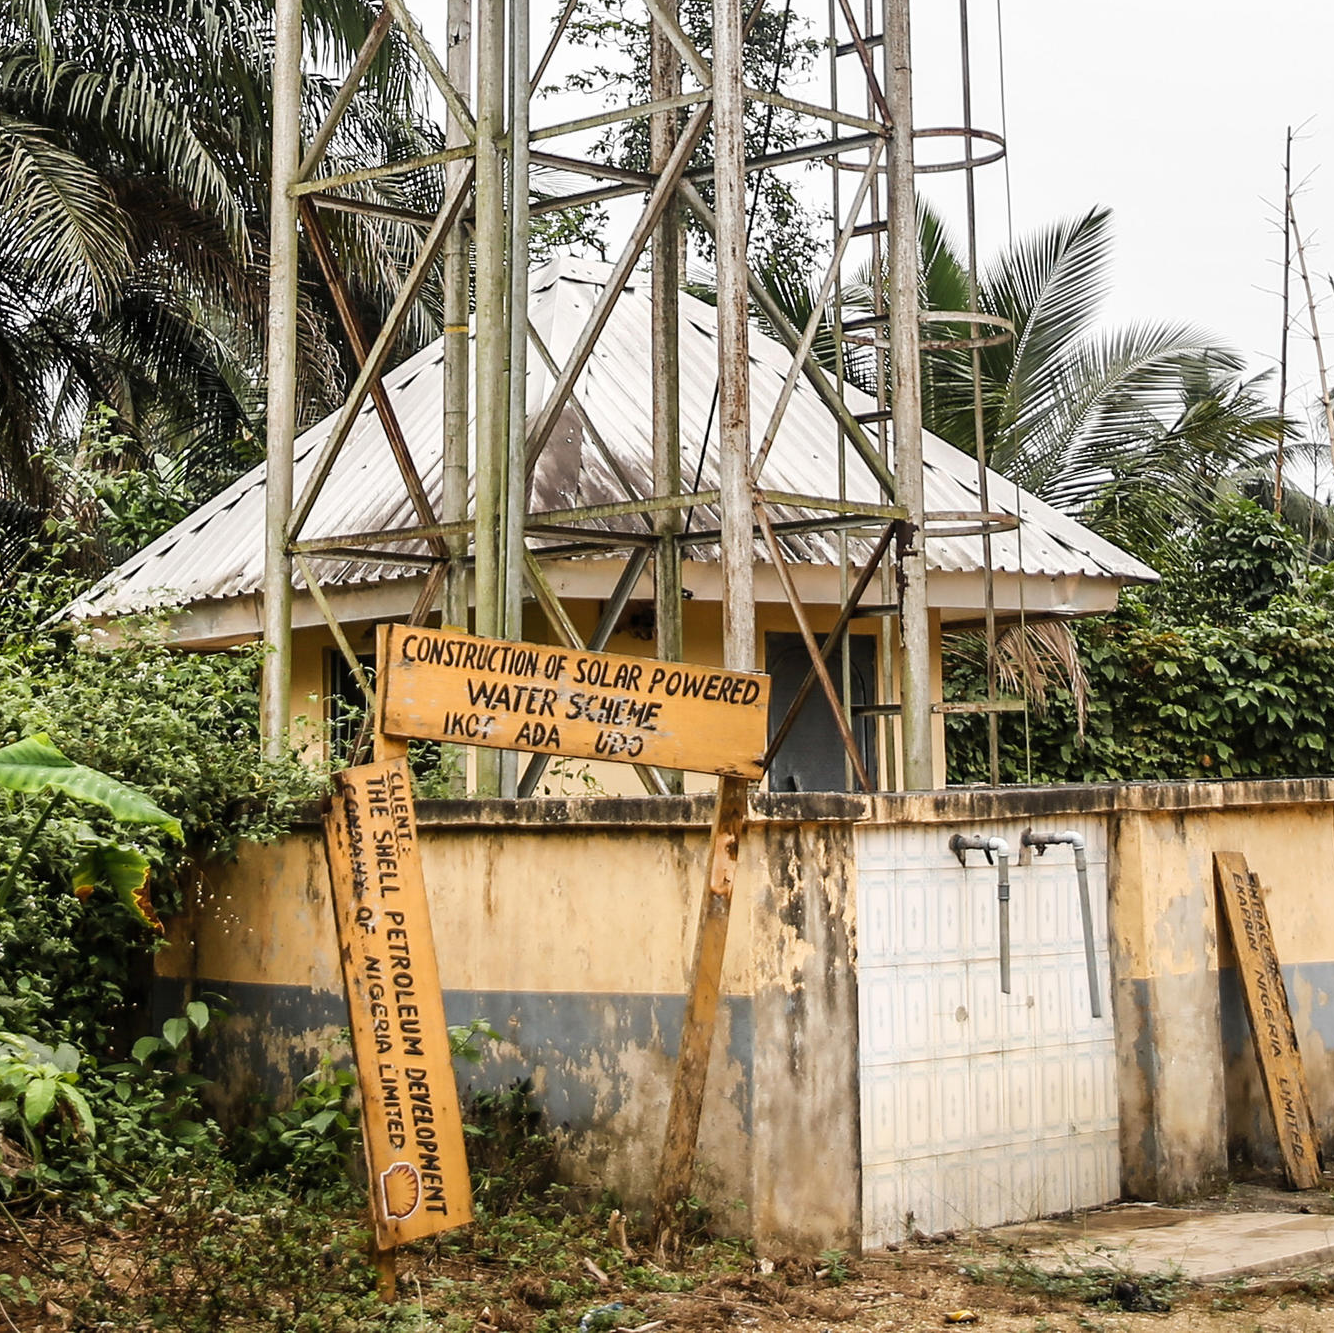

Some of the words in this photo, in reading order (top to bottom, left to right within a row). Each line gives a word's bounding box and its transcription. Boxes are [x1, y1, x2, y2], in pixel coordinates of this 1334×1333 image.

[402, 634, 539, 678] CONSTRUCTION
[544, 654, 567, 681] OF
[573, 658, 640, 691] SOLAR
[649, 668, 759, 705] POWERED
[467, 678, 557, 717] WATER
[566, 692, 662, 731] SCHEME
[515, 721, 560, 749] ADA
[594, 730, 644, 757] UDO
[365, 775, 388, 818] THE
[373, 829, 399, 898] SHELL
[355, 907, 377, 935] OF
[384, 911, 424, 1055] PETROLEUM
[1232, 872, 1259, 952] EKAPRIN
[1254, 970, 1282, 1058] NIGERIA
[365, 956, 392, 1053] NIGERIA
[378, 1064, 405, 1151] LIMITED
[405, 1068, 448, 1215] DEVELOPMENT
